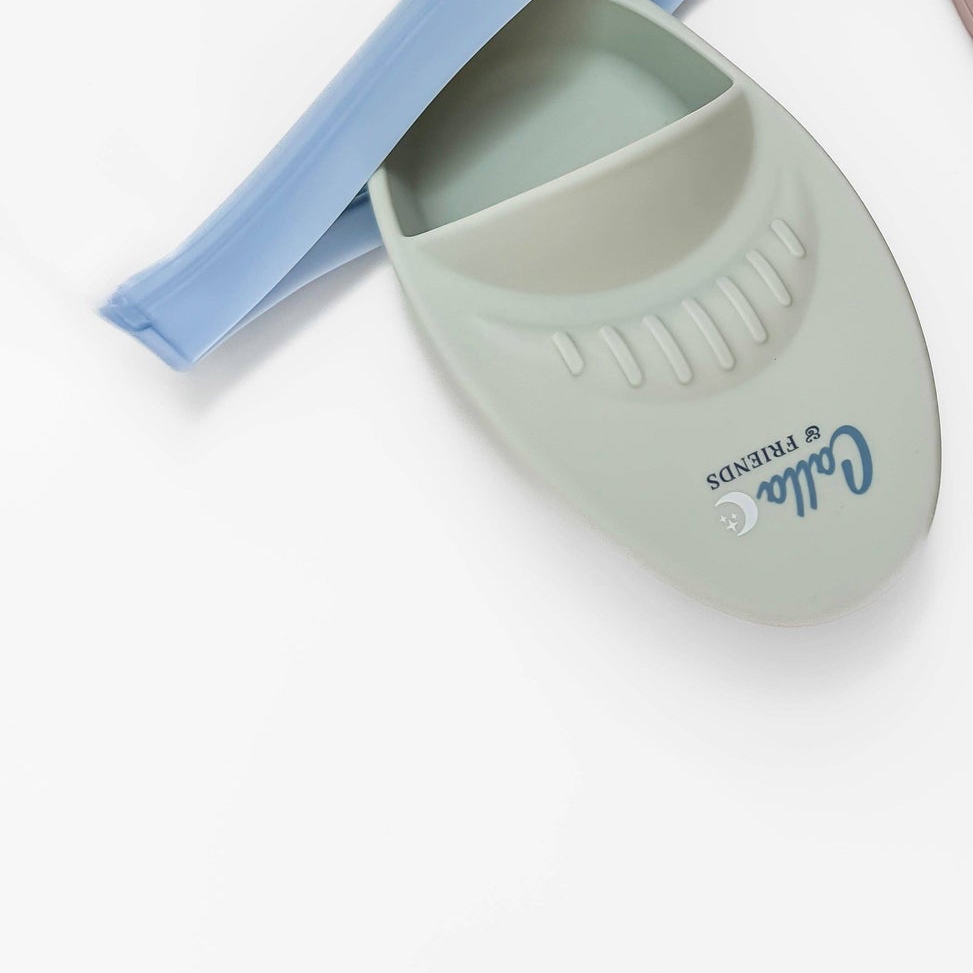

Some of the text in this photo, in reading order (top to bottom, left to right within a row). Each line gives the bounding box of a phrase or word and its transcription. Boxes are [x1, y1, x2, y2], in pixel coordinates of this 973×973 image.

[706, 425, 821, 491] & FRIENDS
[756, 424, 873, 517] Calla
